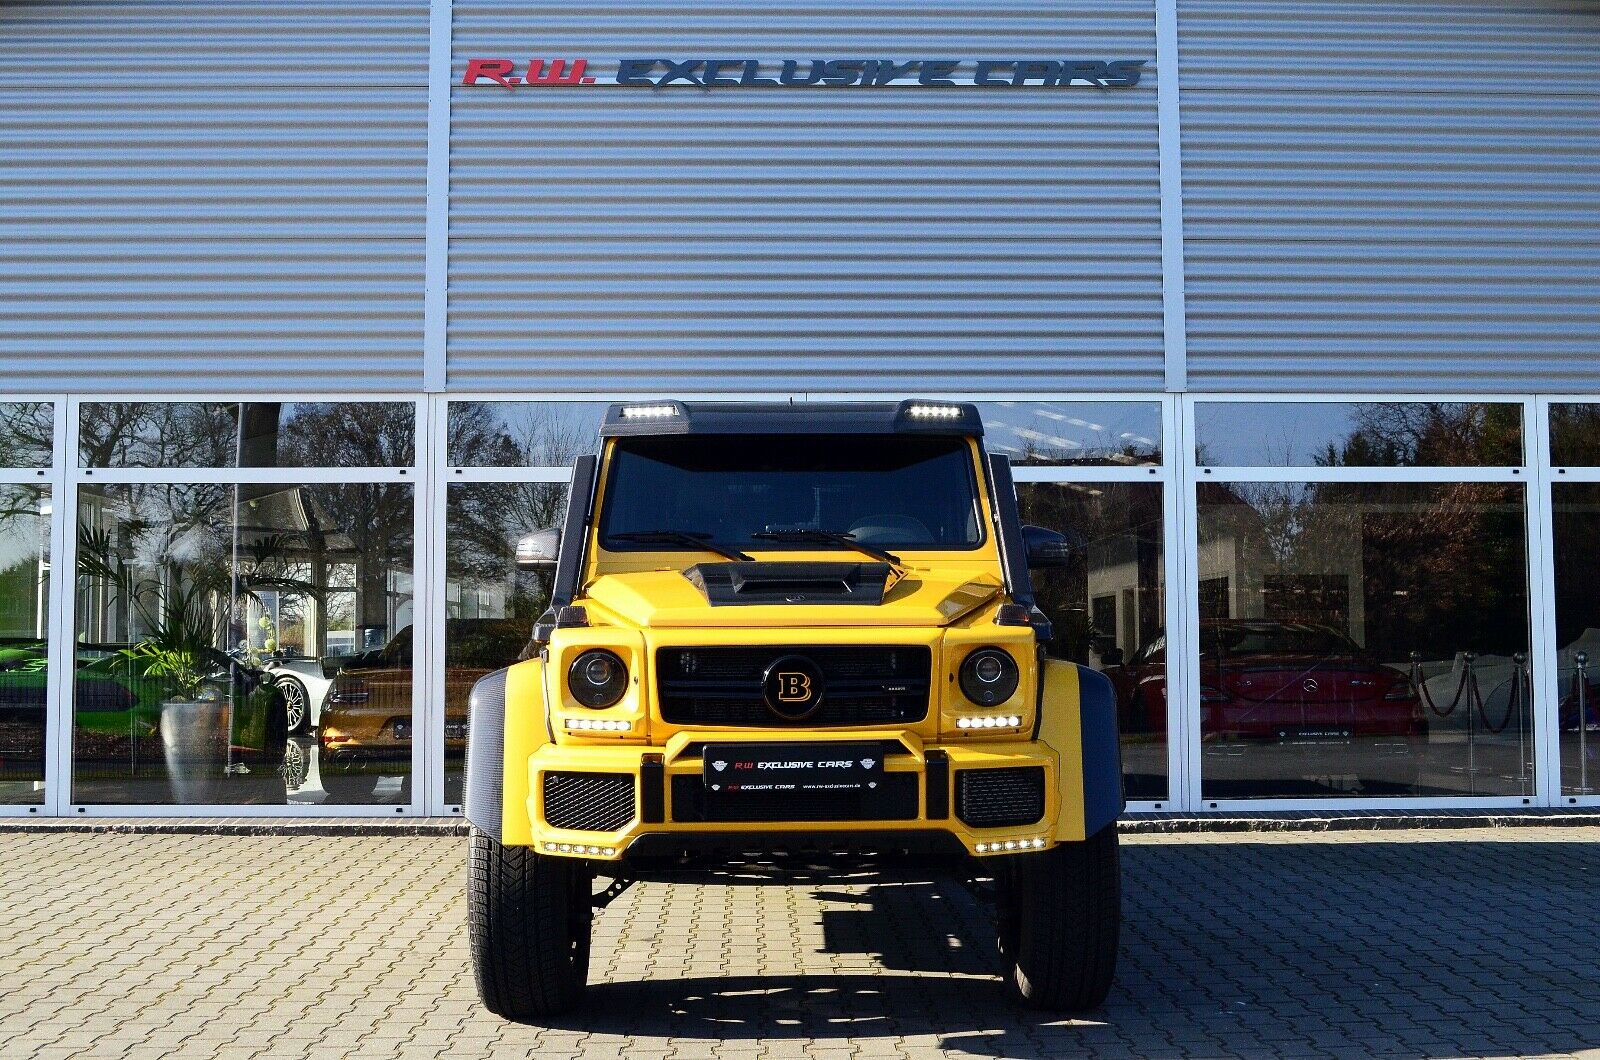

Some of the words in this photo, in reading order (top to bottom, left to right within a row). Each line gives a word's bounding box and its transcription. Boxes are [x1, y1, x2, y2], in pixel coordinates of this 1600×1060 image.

[462, 59, 597, 92] R.W.
[615, 59, 962, 92] EXCLUSIVE
[972, 59, 1149, 93] CARS
[778, 672, 812, 702] B
[757, 761, 814, 770] EXCLUSIVE
[817, 760, 854, 769] CARS
